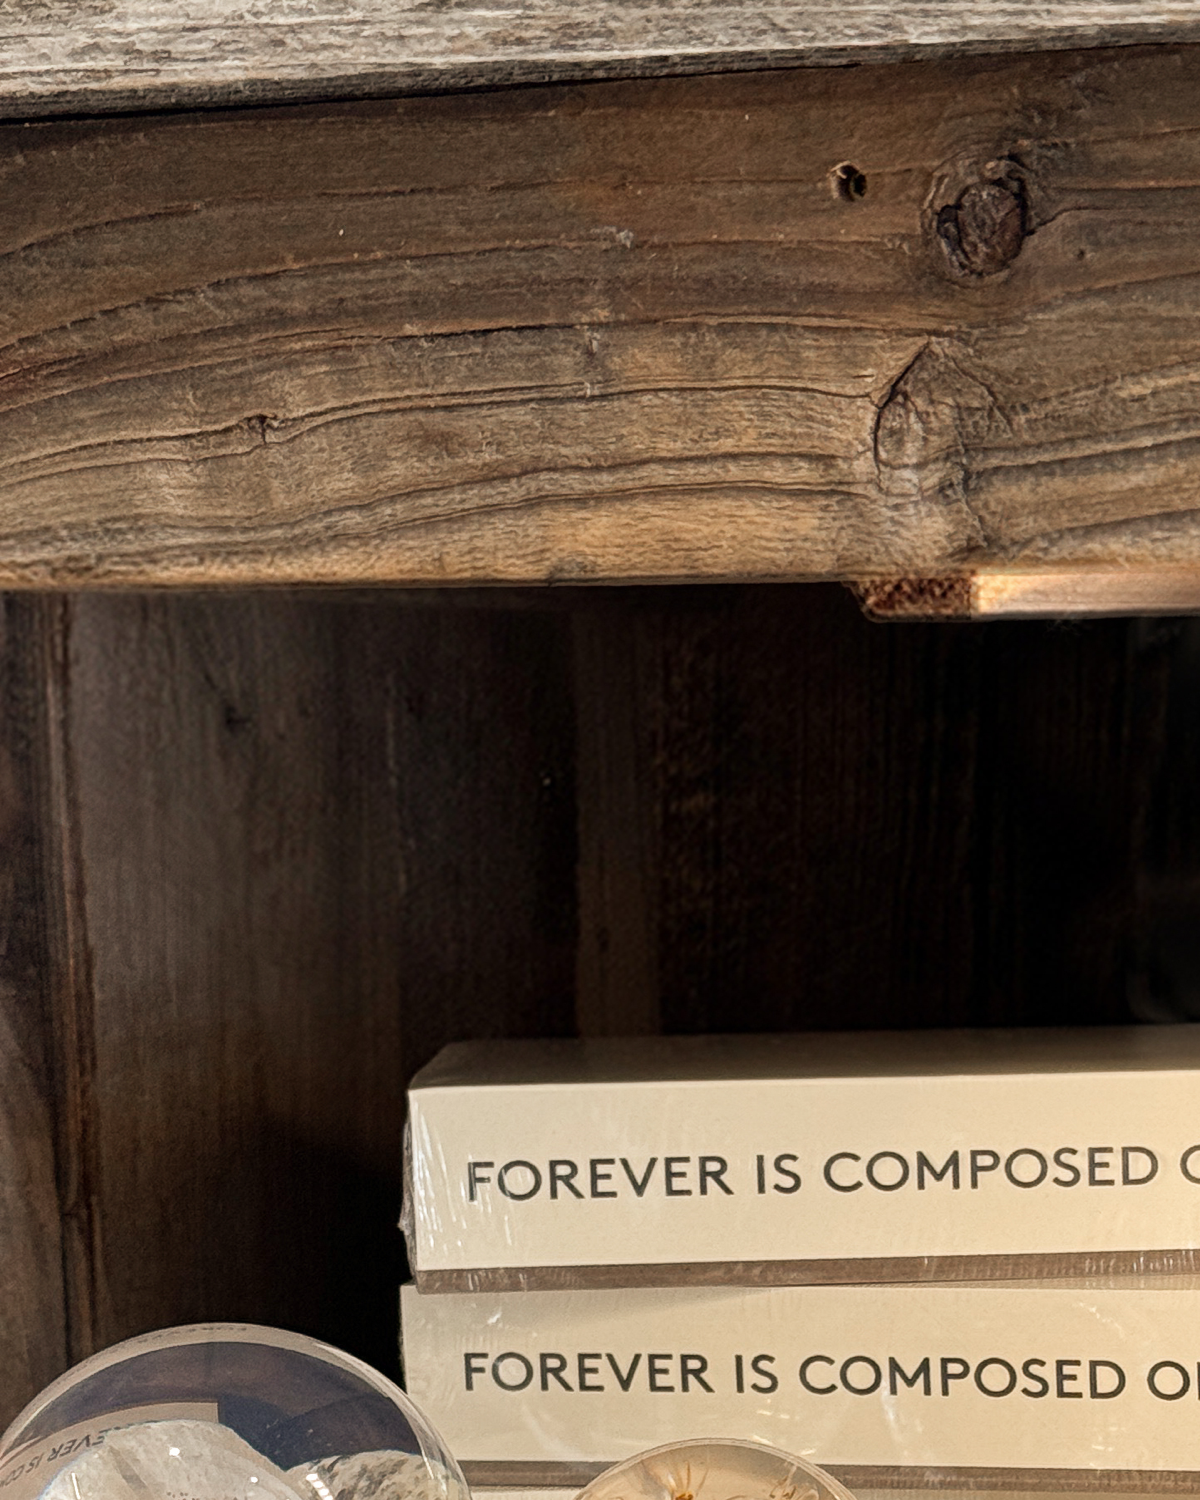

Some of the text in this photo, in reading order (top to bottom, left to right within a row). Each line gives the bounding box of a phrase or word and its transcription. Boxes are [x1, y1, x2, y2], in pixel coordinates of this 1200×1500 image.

[466, 1155, 735, 1202] FOREVER
[756, 1153, 802, 1195] IS
[823, 1146, 1159, 1193] COMPOSED
[463, 1351, 715, 1393] FOREVER
[734, 1353, 779, 1394] IS
[798, 1354, 1126, 1400] COMPOSED
